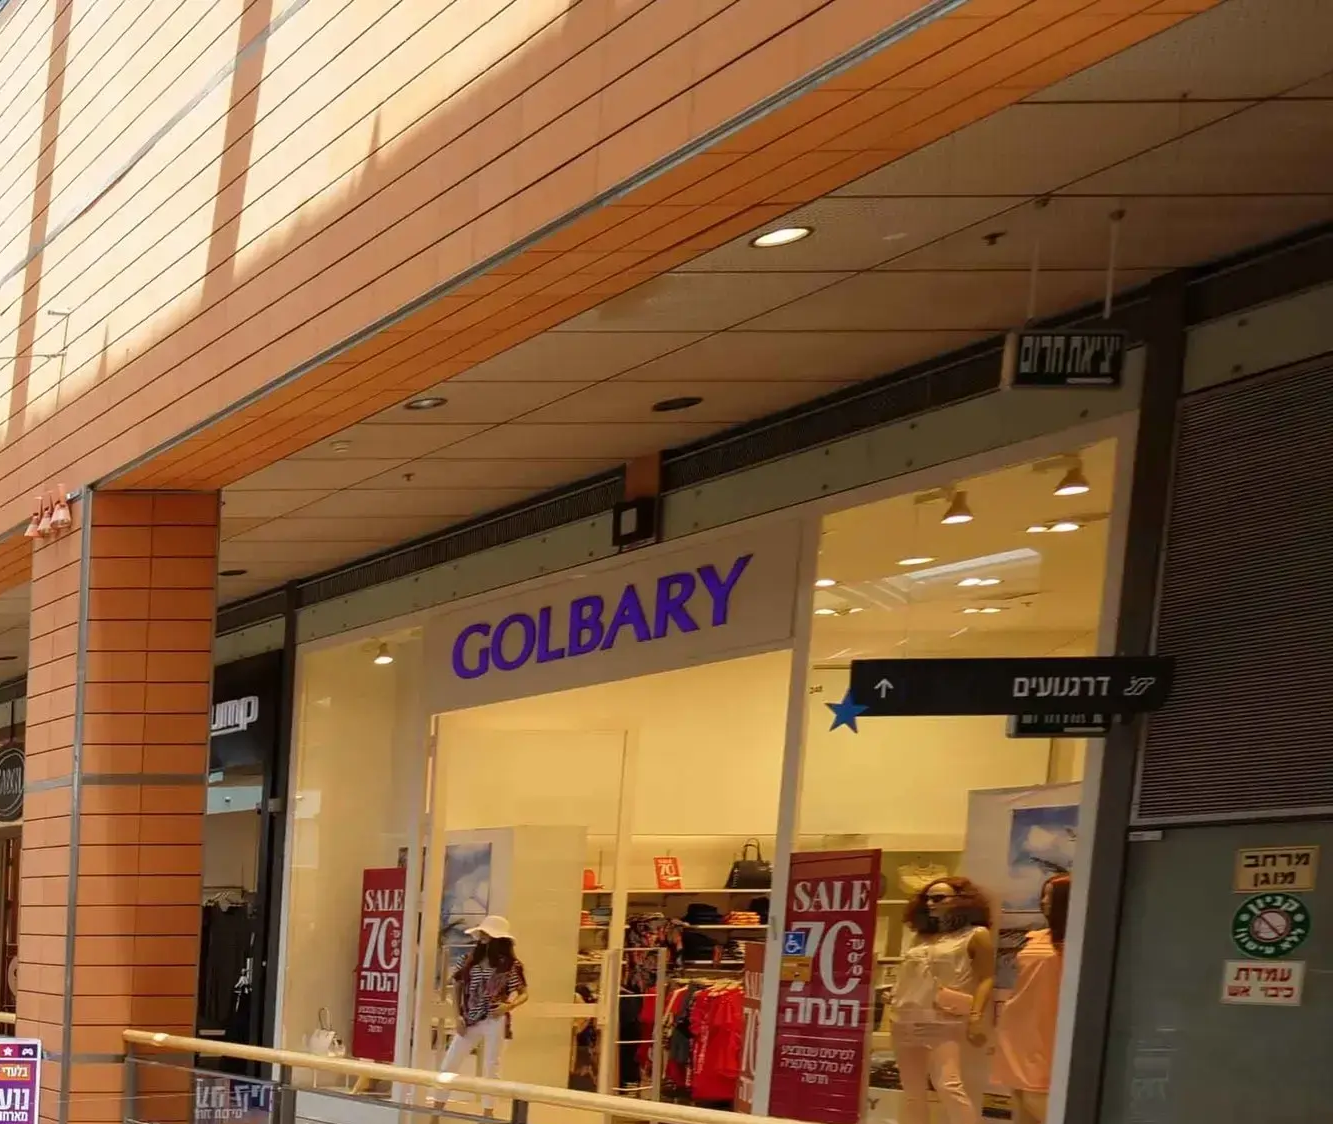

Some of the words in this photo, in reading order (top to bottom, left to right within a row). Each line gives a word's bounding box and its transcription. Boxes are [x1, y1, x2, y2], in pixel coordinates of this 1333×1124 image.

[452, 553, 754, 681] GOLBARY
[1012, 676, 1112, 698] דרגנועים
[211, 695, 259, 736] ump
[1243, 852, 1311, 868] מרחב
[1253, 871, 1297, 888] מוגן
[363, 889, 404, 912] SALE
[792, 880, 872, 913] SALE
[362, 917, 400, 970] 70
[360, 971, 400, 992] הנחה
[1234, 967, 1293, 982] עמדת
[784, 998, 861, 1028] הנחה
[2, 1065, 29, 1077] בלעדי
